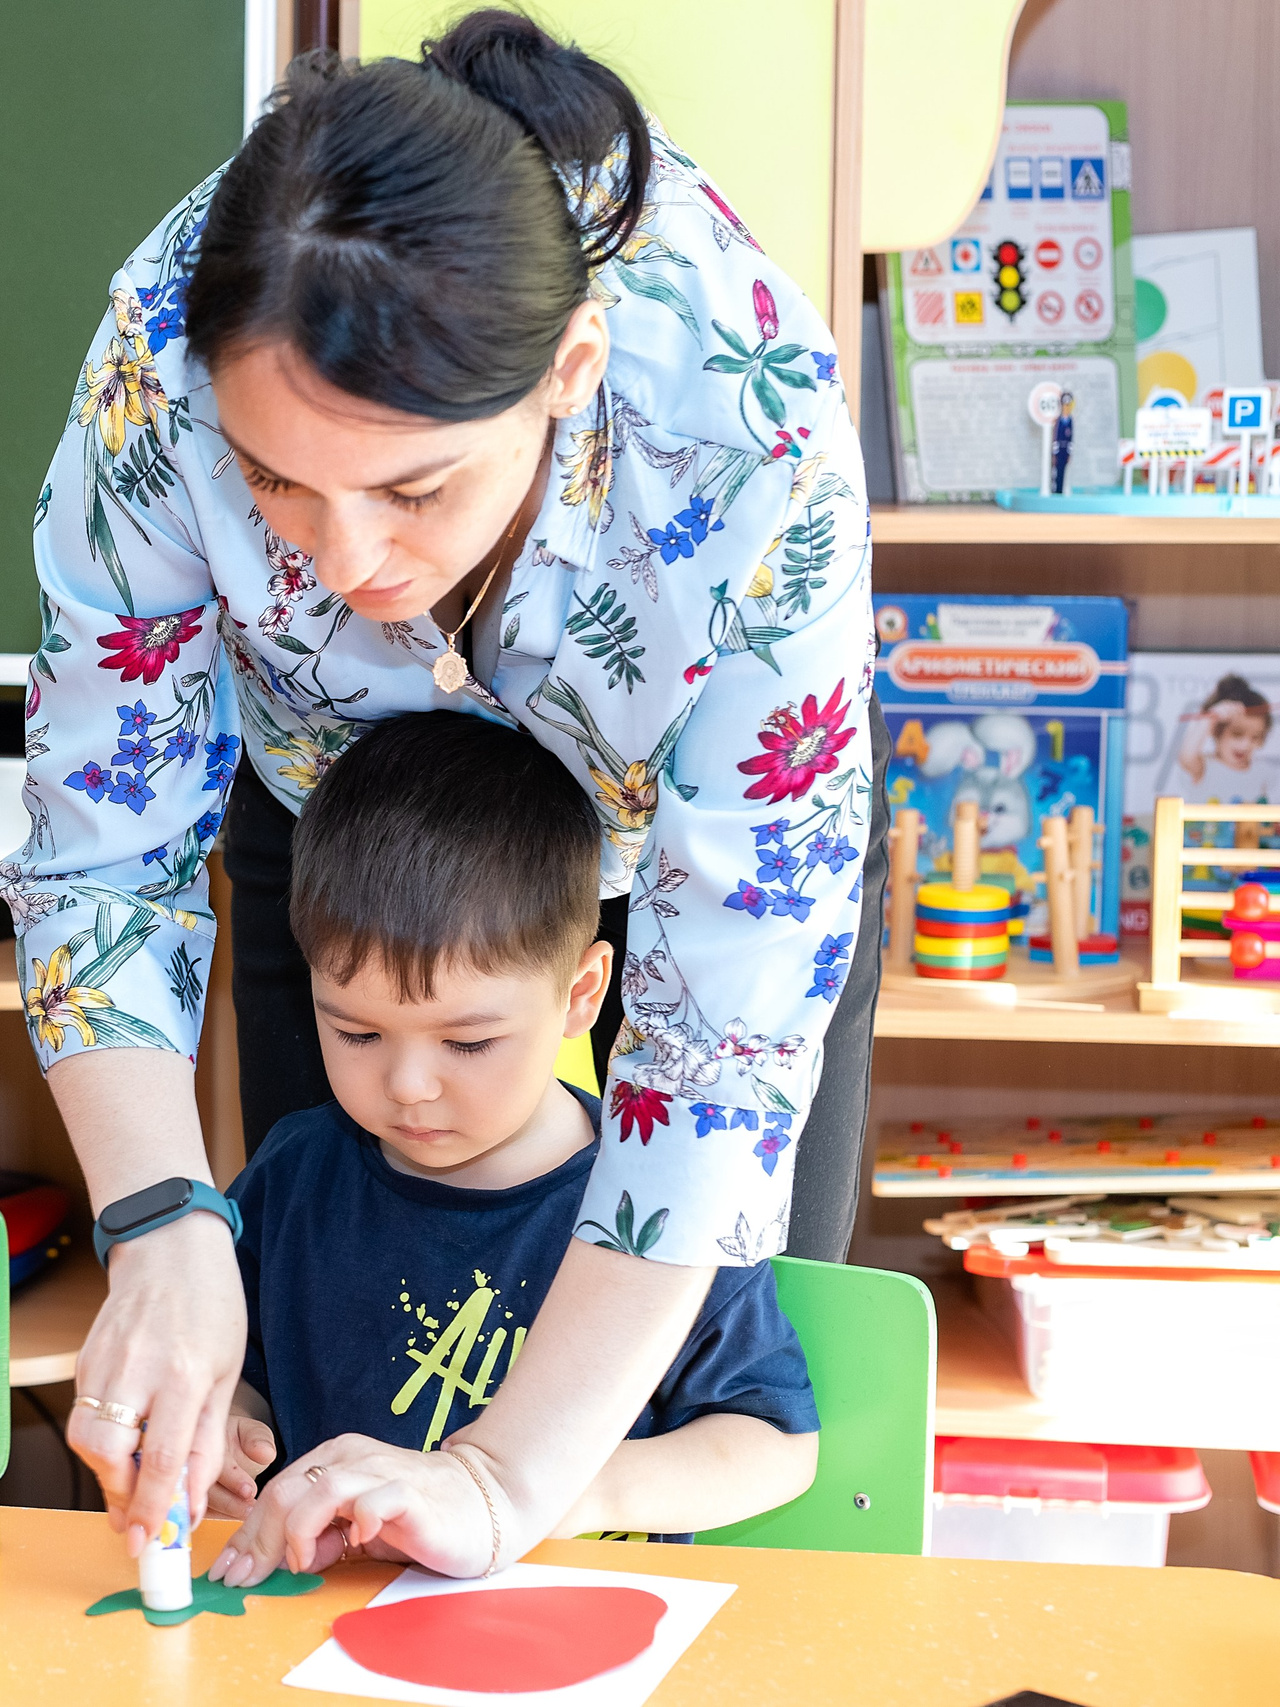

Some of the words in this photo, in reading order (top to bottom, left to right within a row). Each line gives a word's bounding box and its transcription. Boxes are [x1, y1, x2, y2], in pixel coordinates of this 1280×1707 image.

[1234, 399, 1255, 425] P
[896, 719, 930, 766] 4
[1045, 720, 1064, 762] 1
